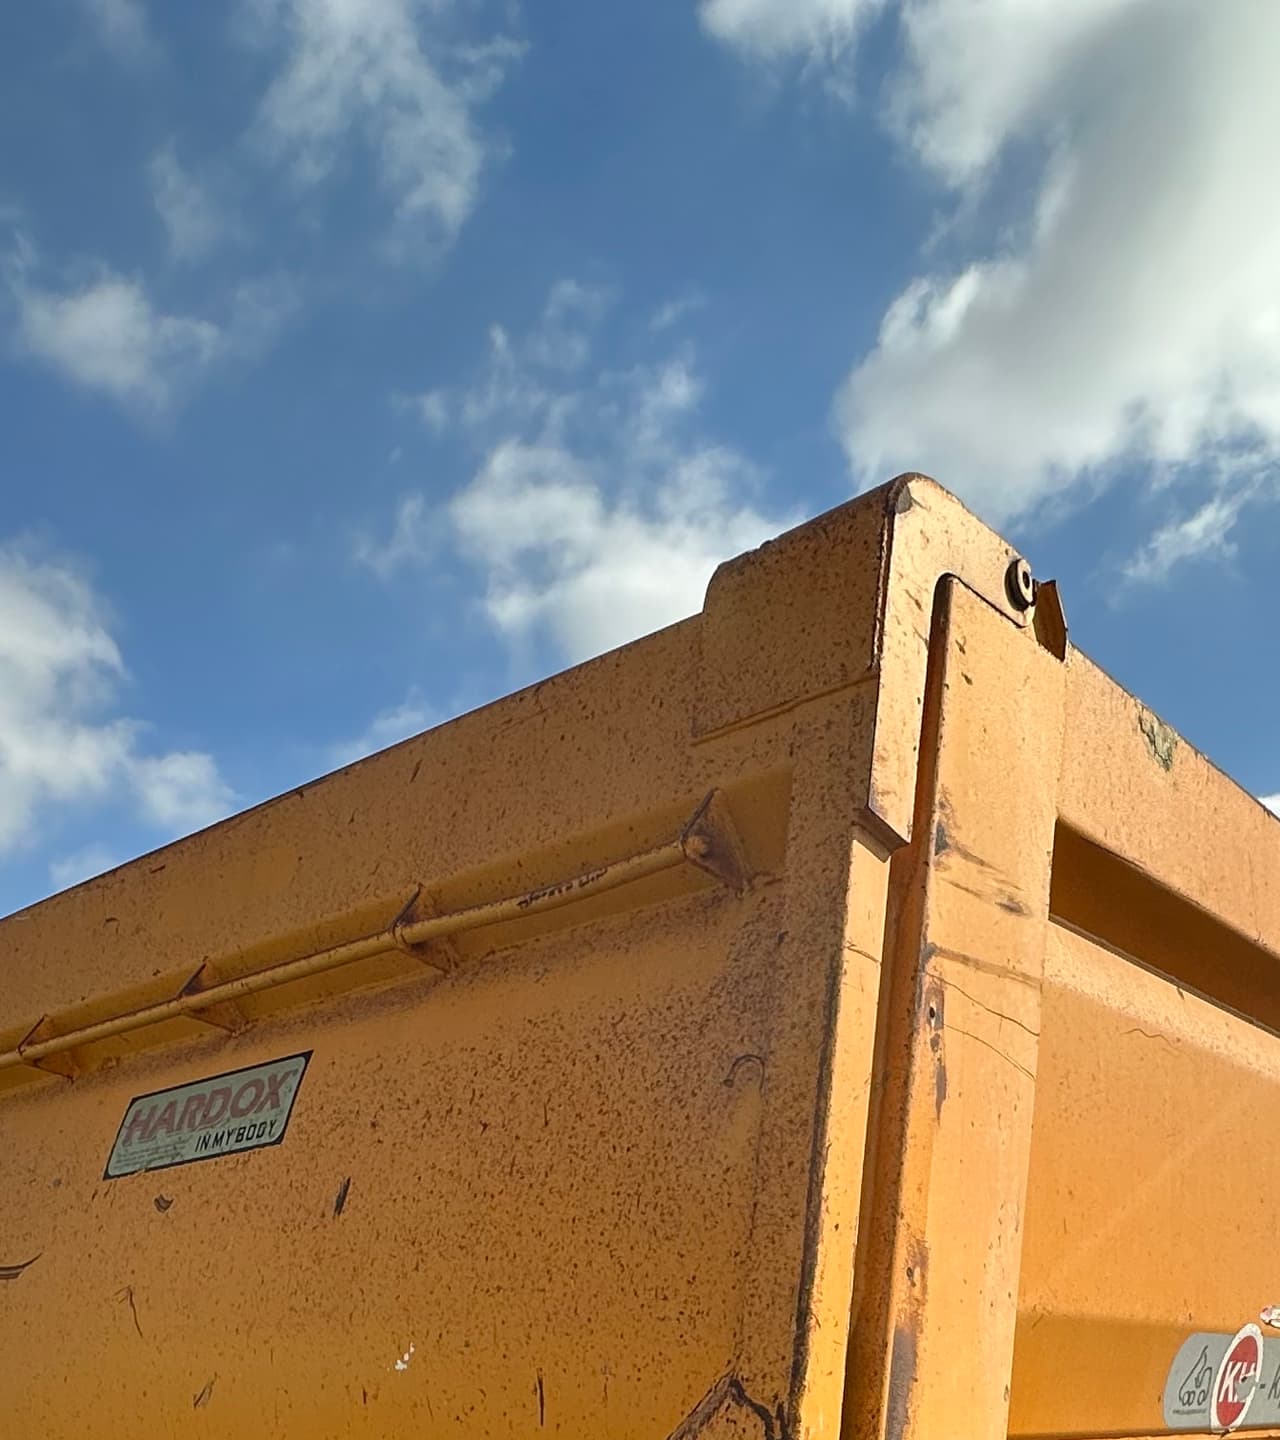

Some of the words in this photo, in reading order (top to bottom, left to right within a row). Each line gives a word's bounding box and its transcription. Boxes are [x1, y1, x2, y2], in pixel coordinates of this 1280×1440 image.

[122, 1068, 298, 1147] HARDOX
[194, 1131, 210, 1153] IN
[212, 1126, 235, 1149] MY
[235, 1118, 278, 1143] BODY
